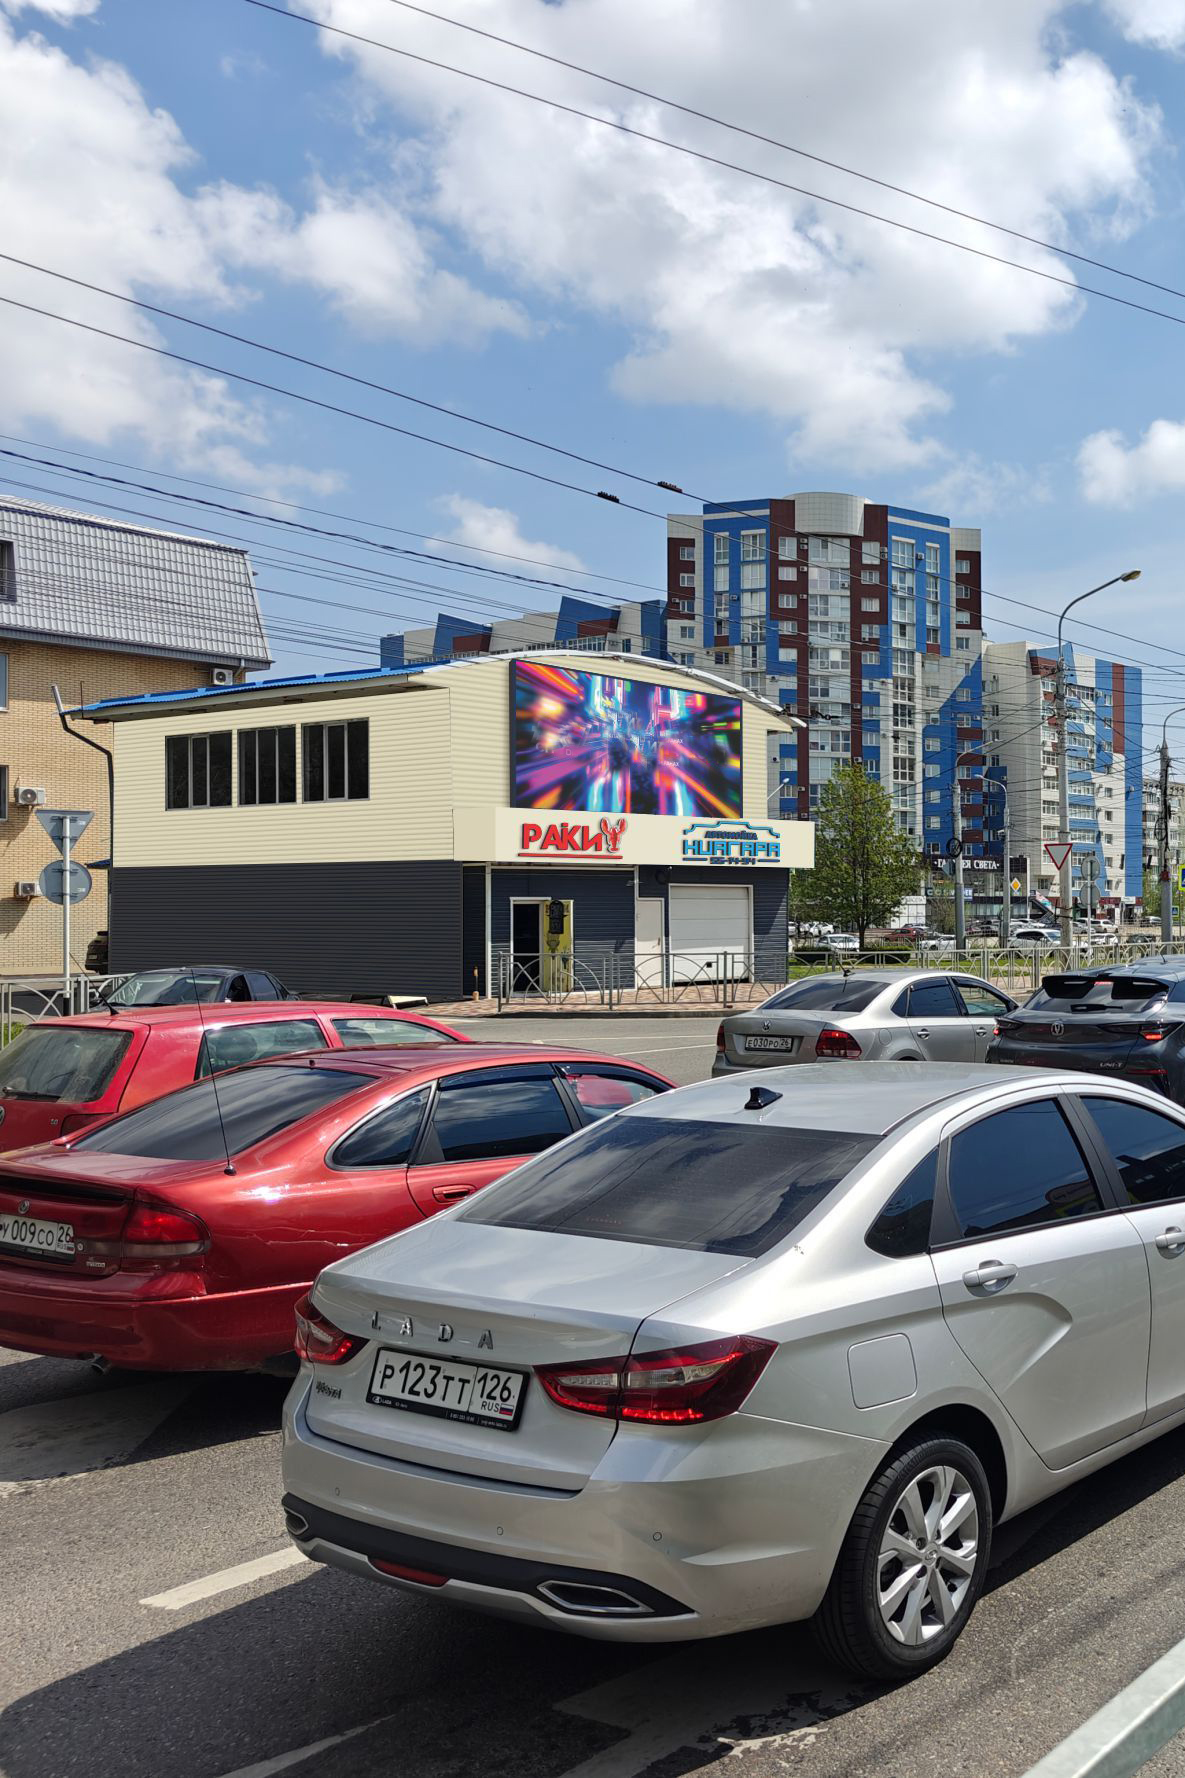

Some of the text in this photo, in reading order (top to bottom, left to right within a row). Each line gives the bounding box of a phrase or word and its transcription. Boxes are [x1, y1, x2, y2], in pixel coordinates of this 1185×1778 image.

[521, 822, 603, 852] РАКИ
[682, 839, 781, 858] НИАГАРА
[973, 860, 998, 870] СВЕТА
[371, 1310, 494, 1350] LADA
[480, 1399, 499, 1413] RUS
